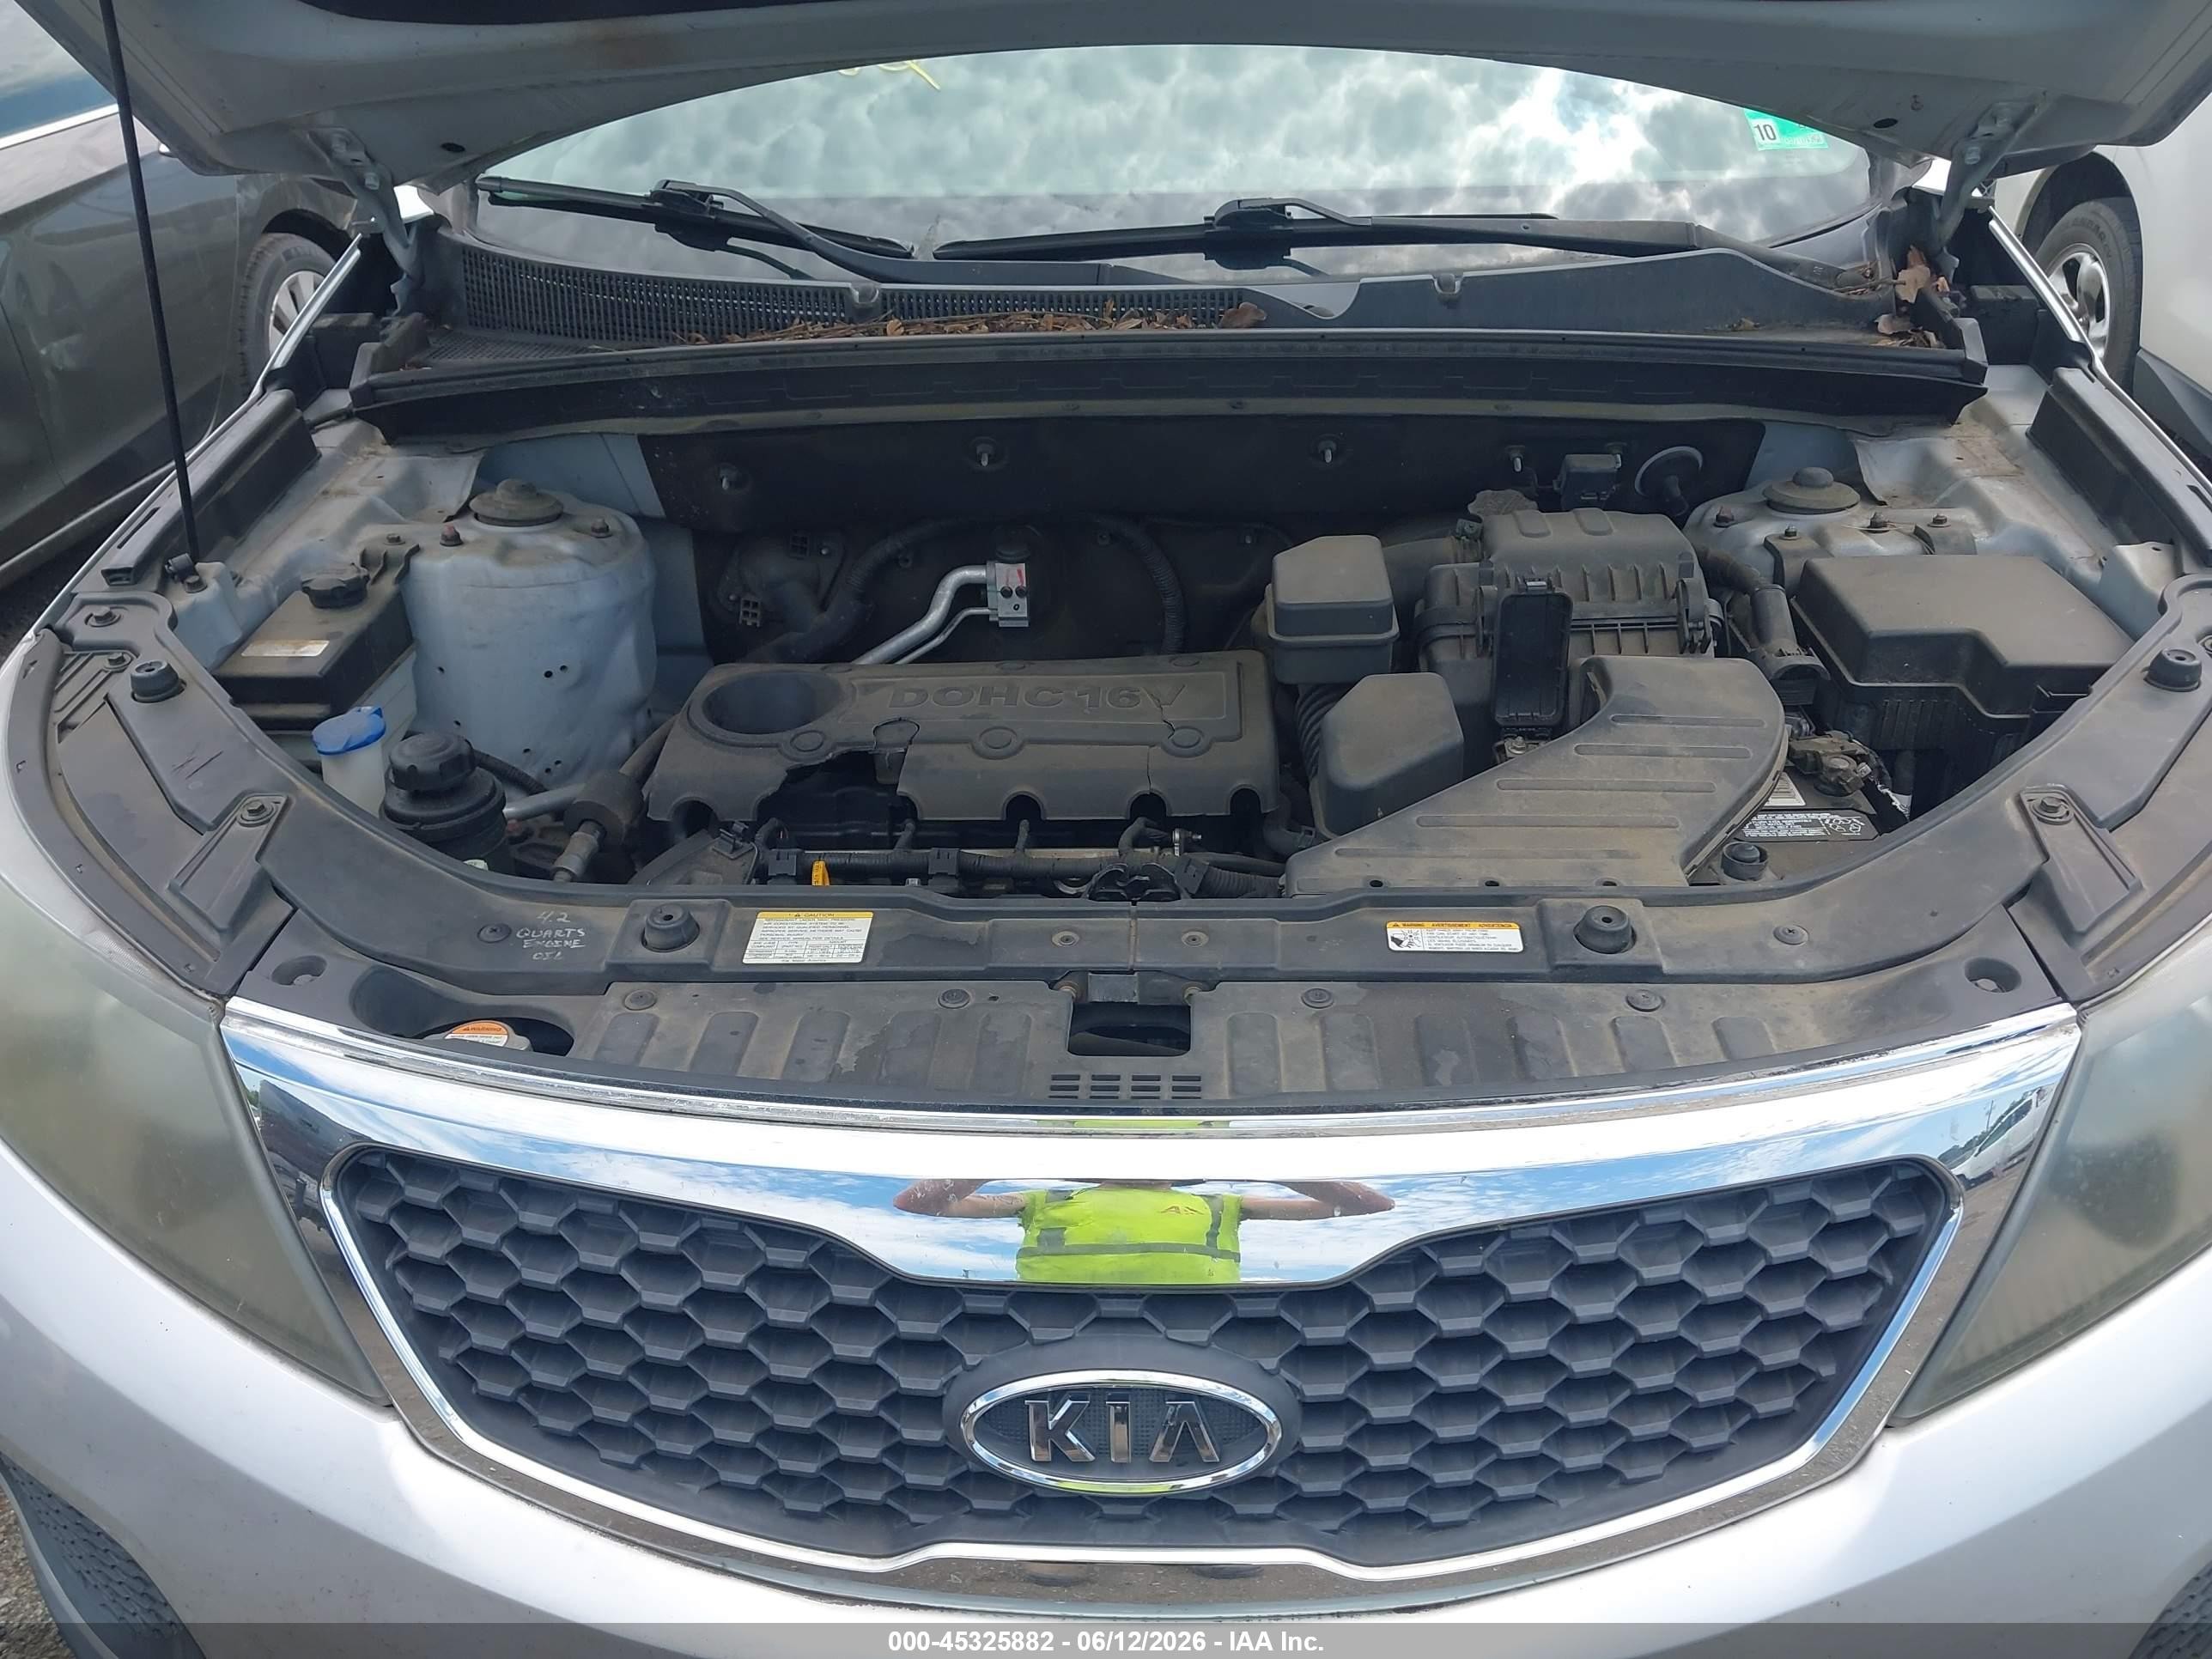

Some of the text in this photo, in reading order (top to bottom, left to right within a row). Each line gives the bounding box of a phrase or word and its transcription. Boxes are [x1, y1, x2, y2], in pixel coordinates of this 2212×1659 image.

[1753, 124, 1777, 141] 10
[888, 684, 1186, 708] DOHC 16V
[516, 927, 586, 939] QUARTS
[532, 951, 563, 961] OIL
[1024, 1400, 1221, 1464] KIA
